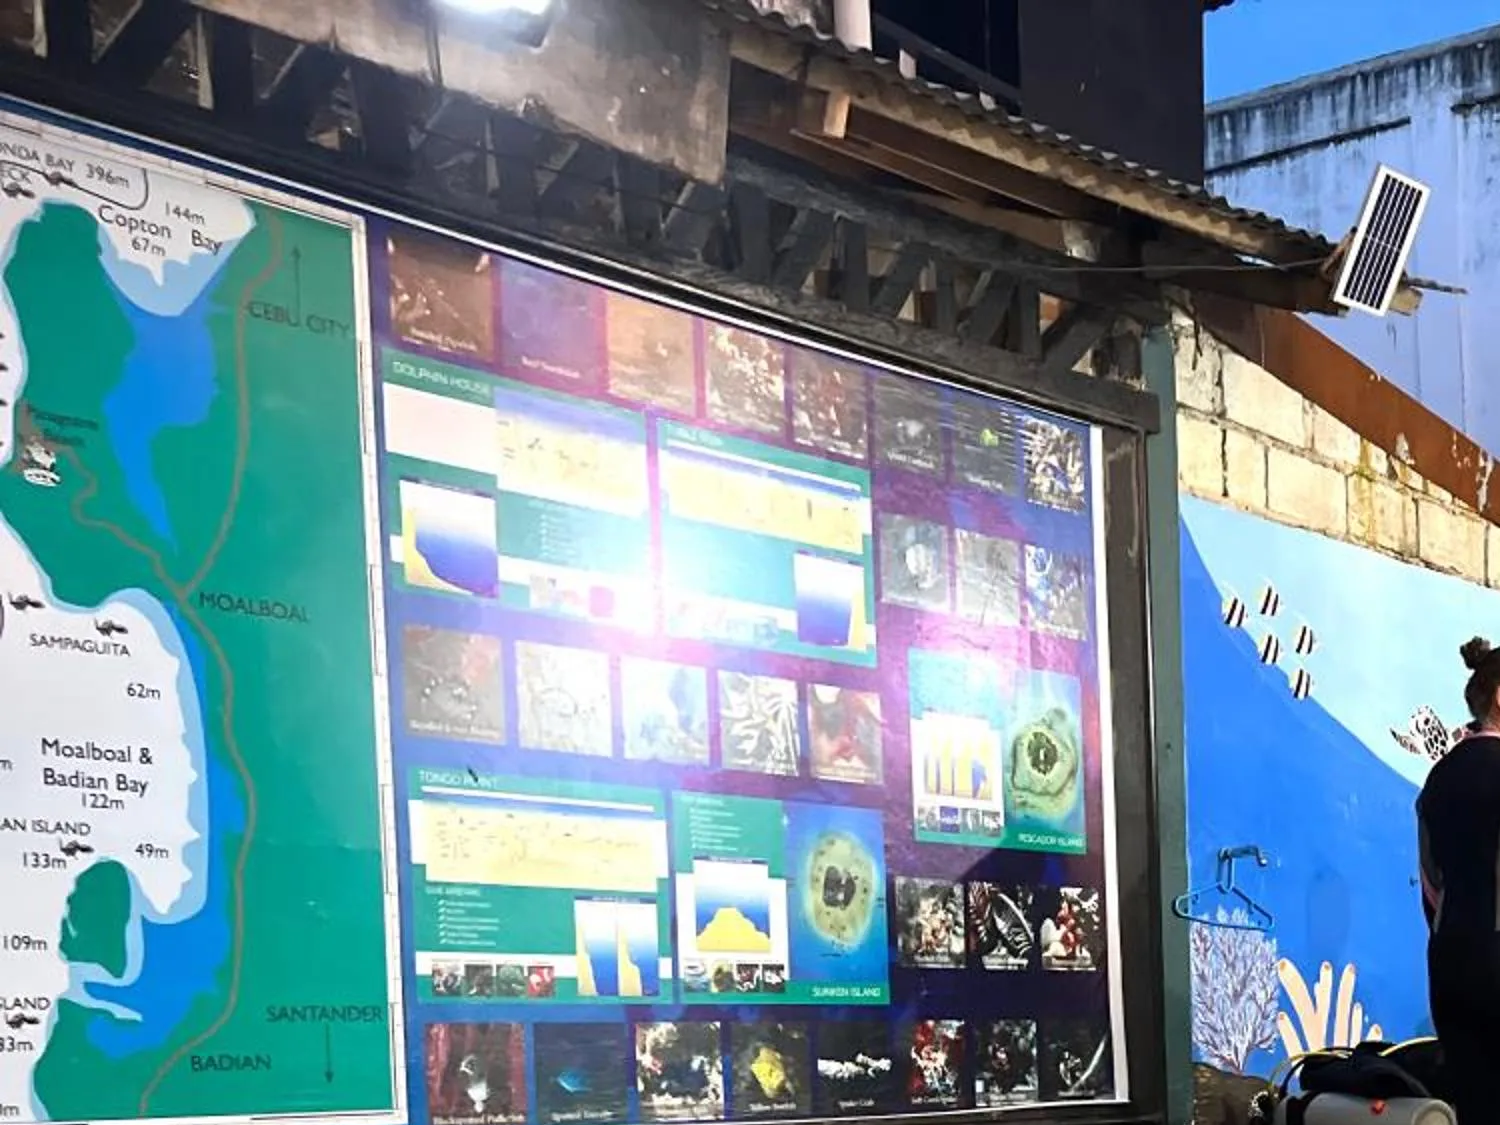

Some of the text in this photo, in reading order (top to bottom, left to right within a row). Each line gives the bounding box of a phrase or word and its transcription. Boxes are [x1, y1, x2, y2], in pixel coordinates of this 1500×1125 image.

[0, 141, 130, 188] NDA BAY 396m
[165, 201, 206, 226] 144m
[98, 203, 223, 256] Copton Bay
[131, 237, 166, 257] 67m
[248, 302, 352, 339] CEBU CITY
[200, 591, 310, 623] MOALBOAL
[29, 632, 131, 657] SAMPAGUITA
[126, 682, 161, 701] 62m
[41, 737, 153, 766] Moalboal &
[43, 768, 149, 797] Badian Bay
[81, 793, 125, 810] 122m
[32, 818, 91, 837] ISLAND
[23, 851, 67, 869] 133m
[135, 844, 169, 860] 49m
[3, 934, 48, 952] 109m
[266, 1005, 383, 1023] SANTANDER
[191, 1055, 271, 1072] BADIAN
